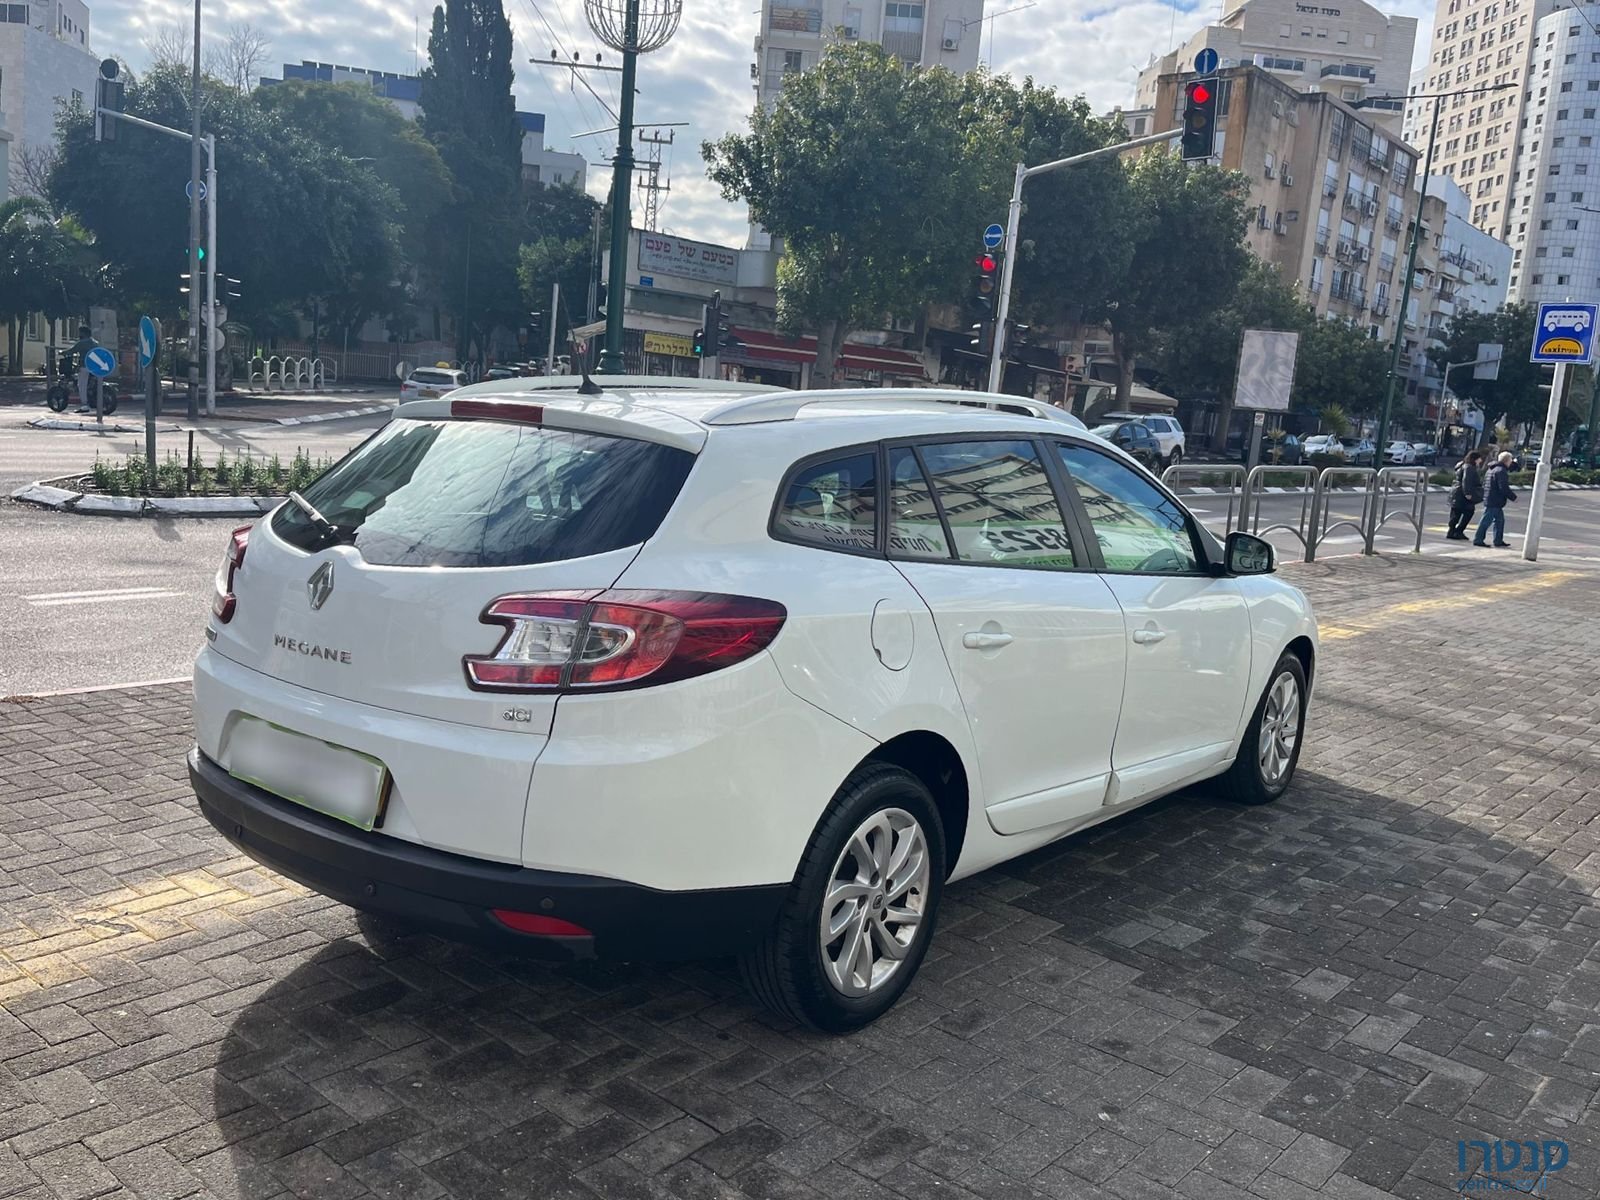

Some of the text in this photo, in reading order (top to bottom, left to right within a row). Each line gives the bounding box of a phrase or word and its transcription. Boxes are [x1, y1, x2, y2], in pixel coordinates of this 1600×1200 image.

[645, 238, 672, 253] פעם
[678, 241, 696, 257] של
[702, 250, 734, 265] בטעם
[653, 342, 693, 356] נדלריה
[274, 633, 352, 665] MEGANE
